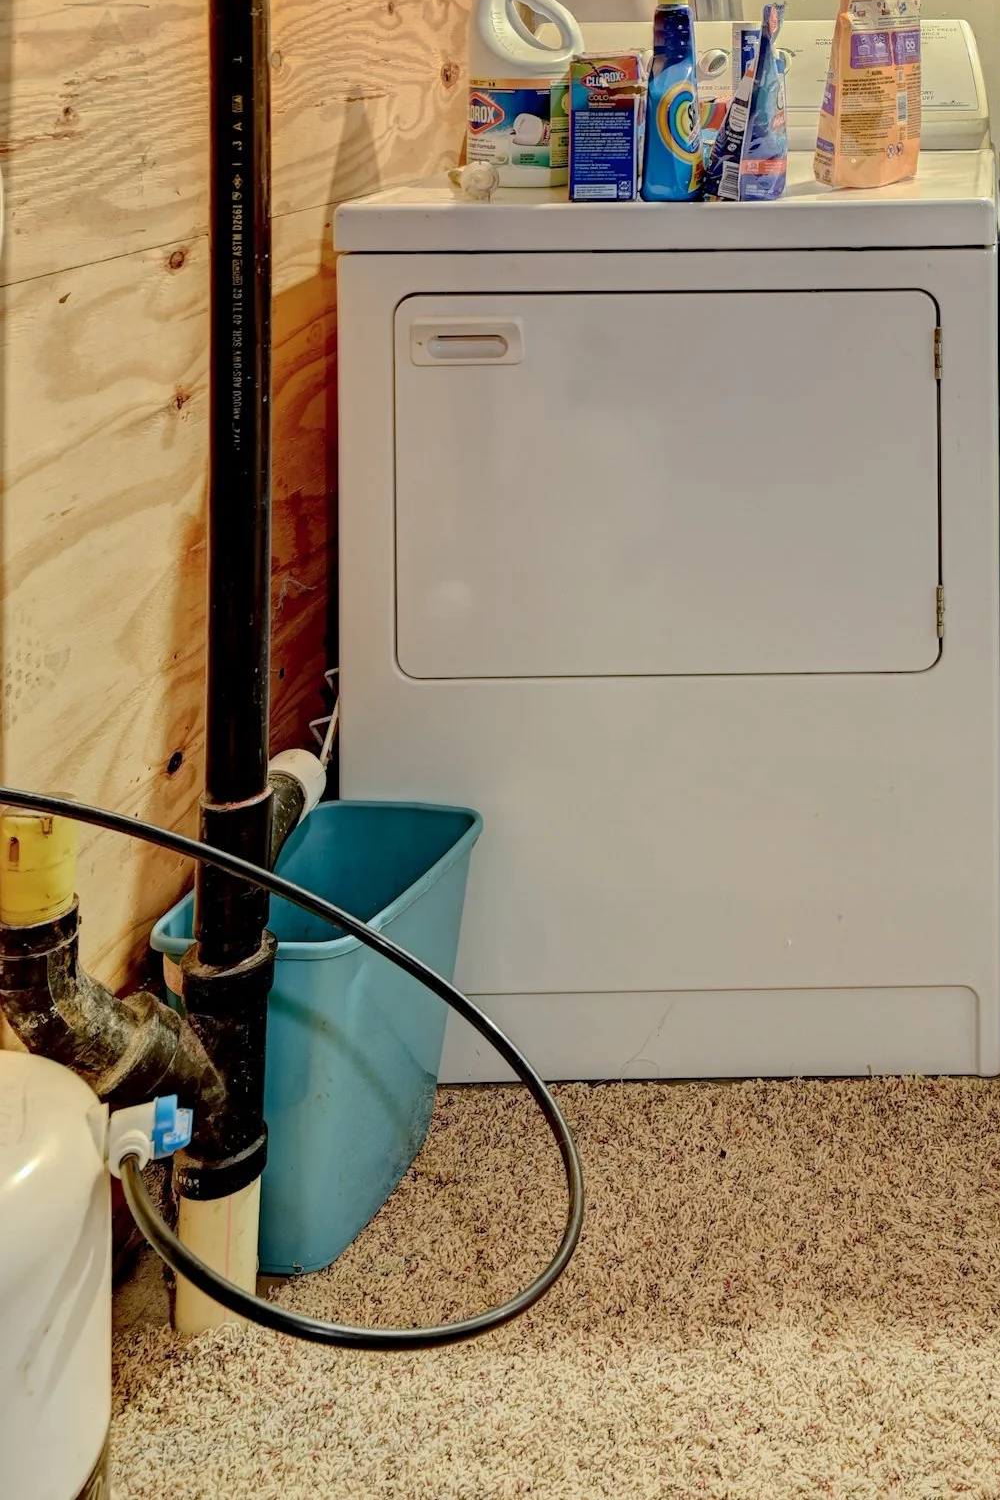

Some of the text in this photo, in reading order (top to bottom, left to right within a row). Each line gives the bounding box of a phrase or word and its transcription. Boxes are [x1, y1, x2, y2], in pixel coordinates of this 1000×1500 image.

[232, 204, 242, 231] D2661
[232, 234, 242, 256] ASTM
[232, 350, 242, 387] ABS-DWV
